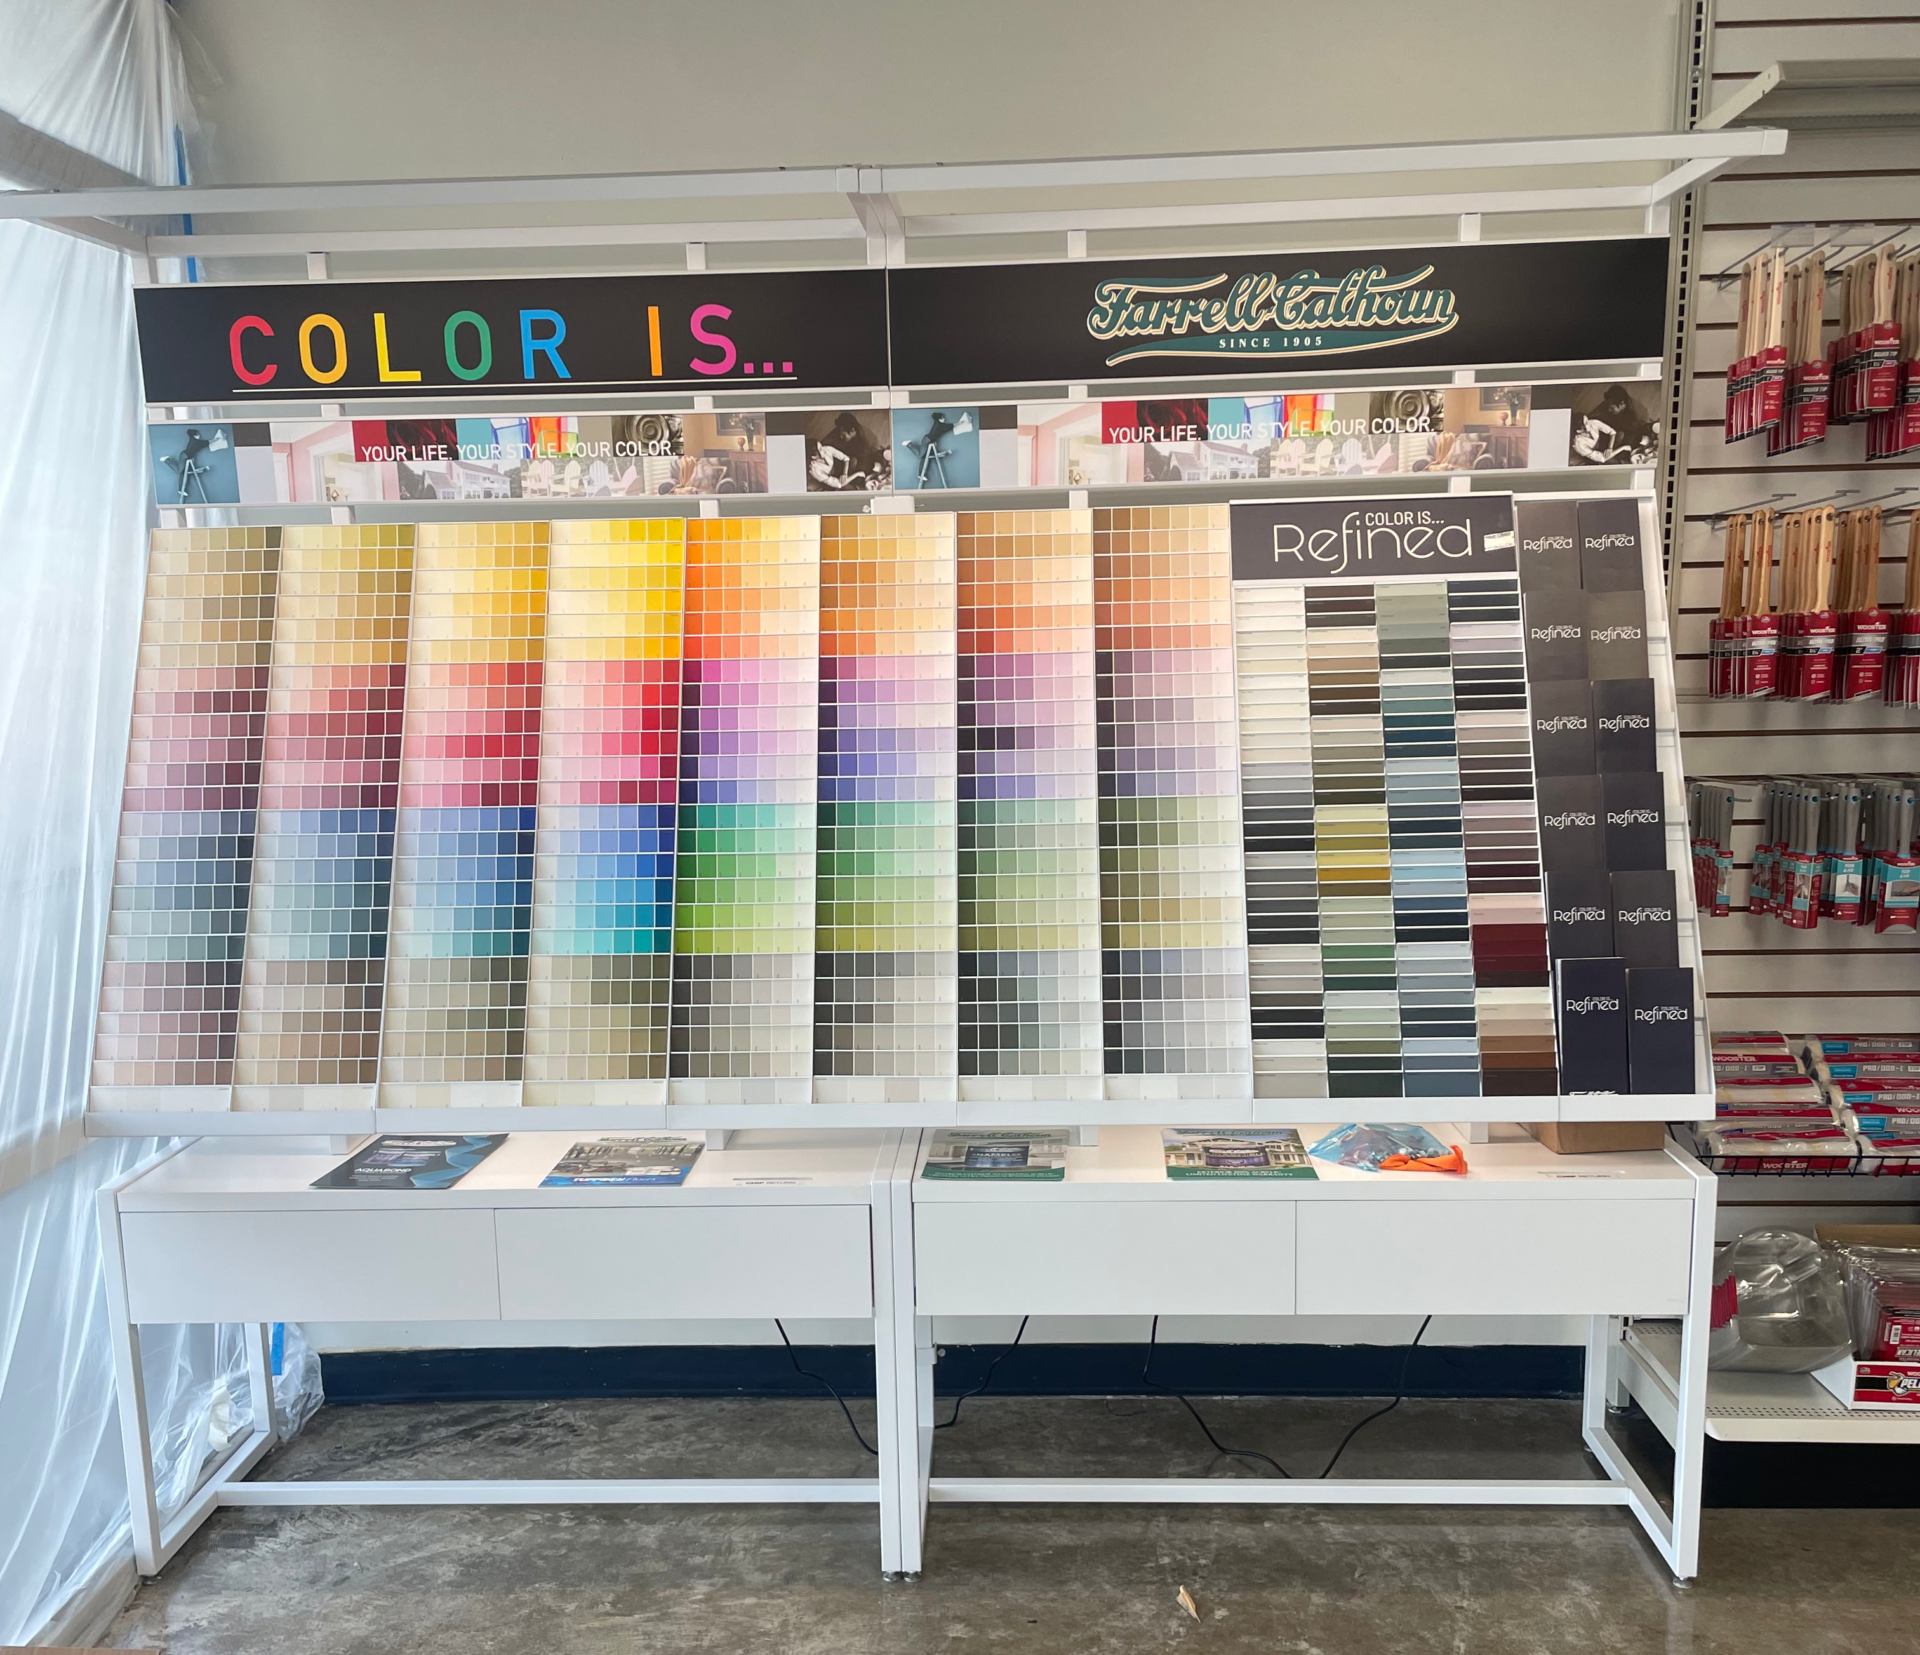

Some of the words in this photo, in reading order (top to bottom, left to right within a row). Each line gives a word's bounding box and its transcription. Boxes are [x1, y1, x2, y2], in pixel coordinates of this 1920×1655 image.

[229, 309, 572, 386] COLOR
[647, 303, 793, 377] IS...
[1219, 338, 1271, 348] SINCE
[1283, 336, 1323, 347] 1905
[1109, 426, 1155, 443] YOUR
[1160, 425, 1202, 441] LIFE.
[1207, 423, 1252, 440] YOUR
[1257, 421, 1315, 438] STYLE.
[1320, 420, 1367, 436] YOUR
[1371, 416, 1436, 434] COLOR.
[361, 445, 407, 461] YOUR
[411, 444, 453, 460] LIFE.
[456, 443, 501, 460] YOUR
[506, 442, 562, 459] STYLE.
[565, 442, 611, 458] YOUR
[615, 440, 677, 457] COLOR.
[1365, 512, 1414, 526] COLOR
[1417, 511, 1445, 525] IS...
[1273, 511, 1473, 574] Refined
[1523, 536, 1573, 553] Refined
[1585, 534, 1635, 551] Refined
[1531, 625, 1581, 642] Refined
[1590, 626, 1641, 643] Refined
[1751, 627, 1777, 635] WOOSTER
[1810, 626, 1836, 634] WOOSTER
[1857, 622, 1887, 630] WOOSTER
[1536, 715, 1587, 733] Refined
[1599, 715, 1650, 733] Refined
[1544, 812, 1596, 830] Refined
[1607, 809, 1659, 827] Refined
[1553, 907, 1606, 925] Refined
[1618, 907, 1671, 925] Refined
[1566, 996, 1619, 1015] Refined
[1634, 1005, 1688, 1024] Refined
[1712, 1054, 1757, 1062] WOOSTER
